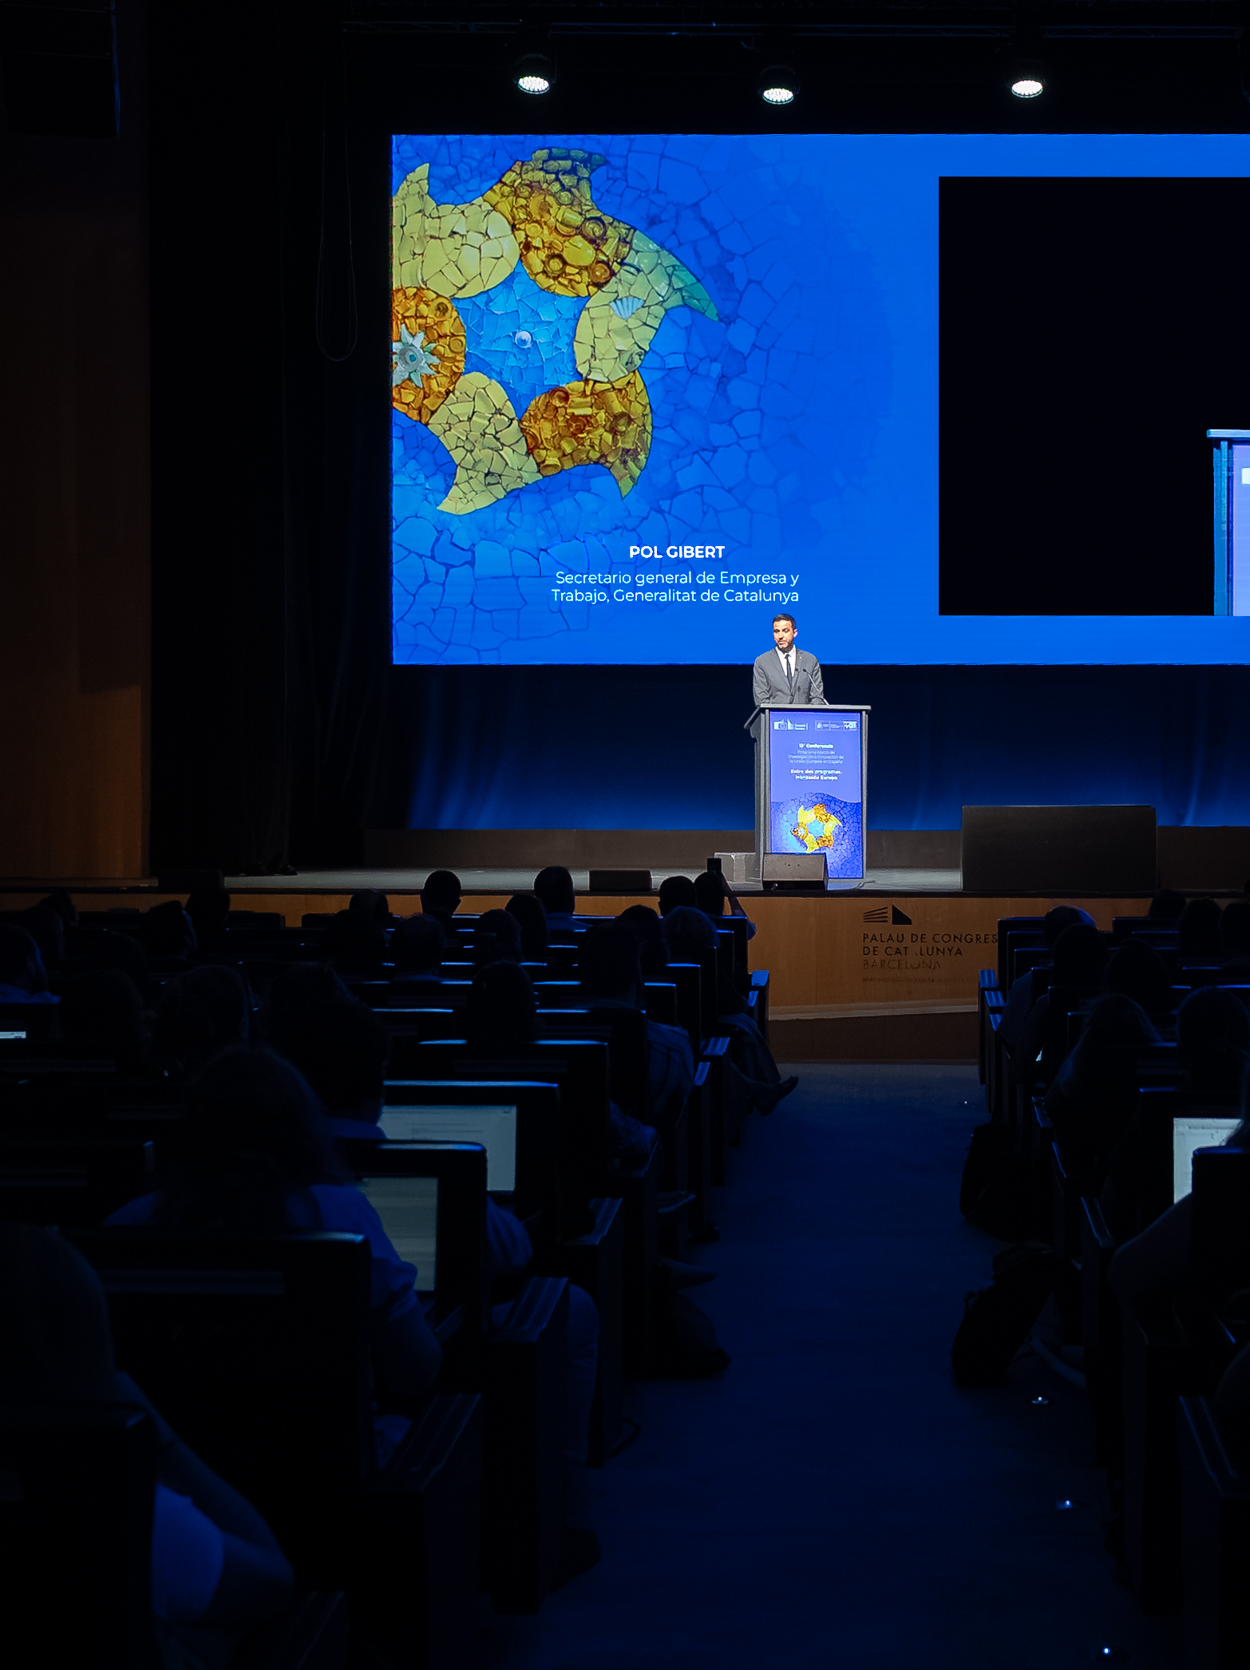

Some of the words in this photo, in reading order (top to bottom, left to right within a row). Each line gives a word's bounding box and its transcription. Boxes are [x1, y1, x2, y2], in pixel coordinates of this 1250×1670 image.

[629, 545, 663, 559] POL
[666, 545, 726, 559] GIBERT
[555, 570, 632, 585] Secretario
[635, 570, 692, 587] general
[695, 570, 716, 585] de
[720, 571, 787, 587] Empresa
[790, 574, 800, 587] y
[551, 588, 610, 605] Trabajo,
[613, 588, 696, 602] Generalitat
[700, 588, 720, 602] de
[724, 588, 799, 605] Catalunya
[862, 933, 905, 944] PALAU
[910, 933, 927, 944] DE
[862, 946, 879, 956] DE
[884, 946, 963, 957] CATLUNYA
